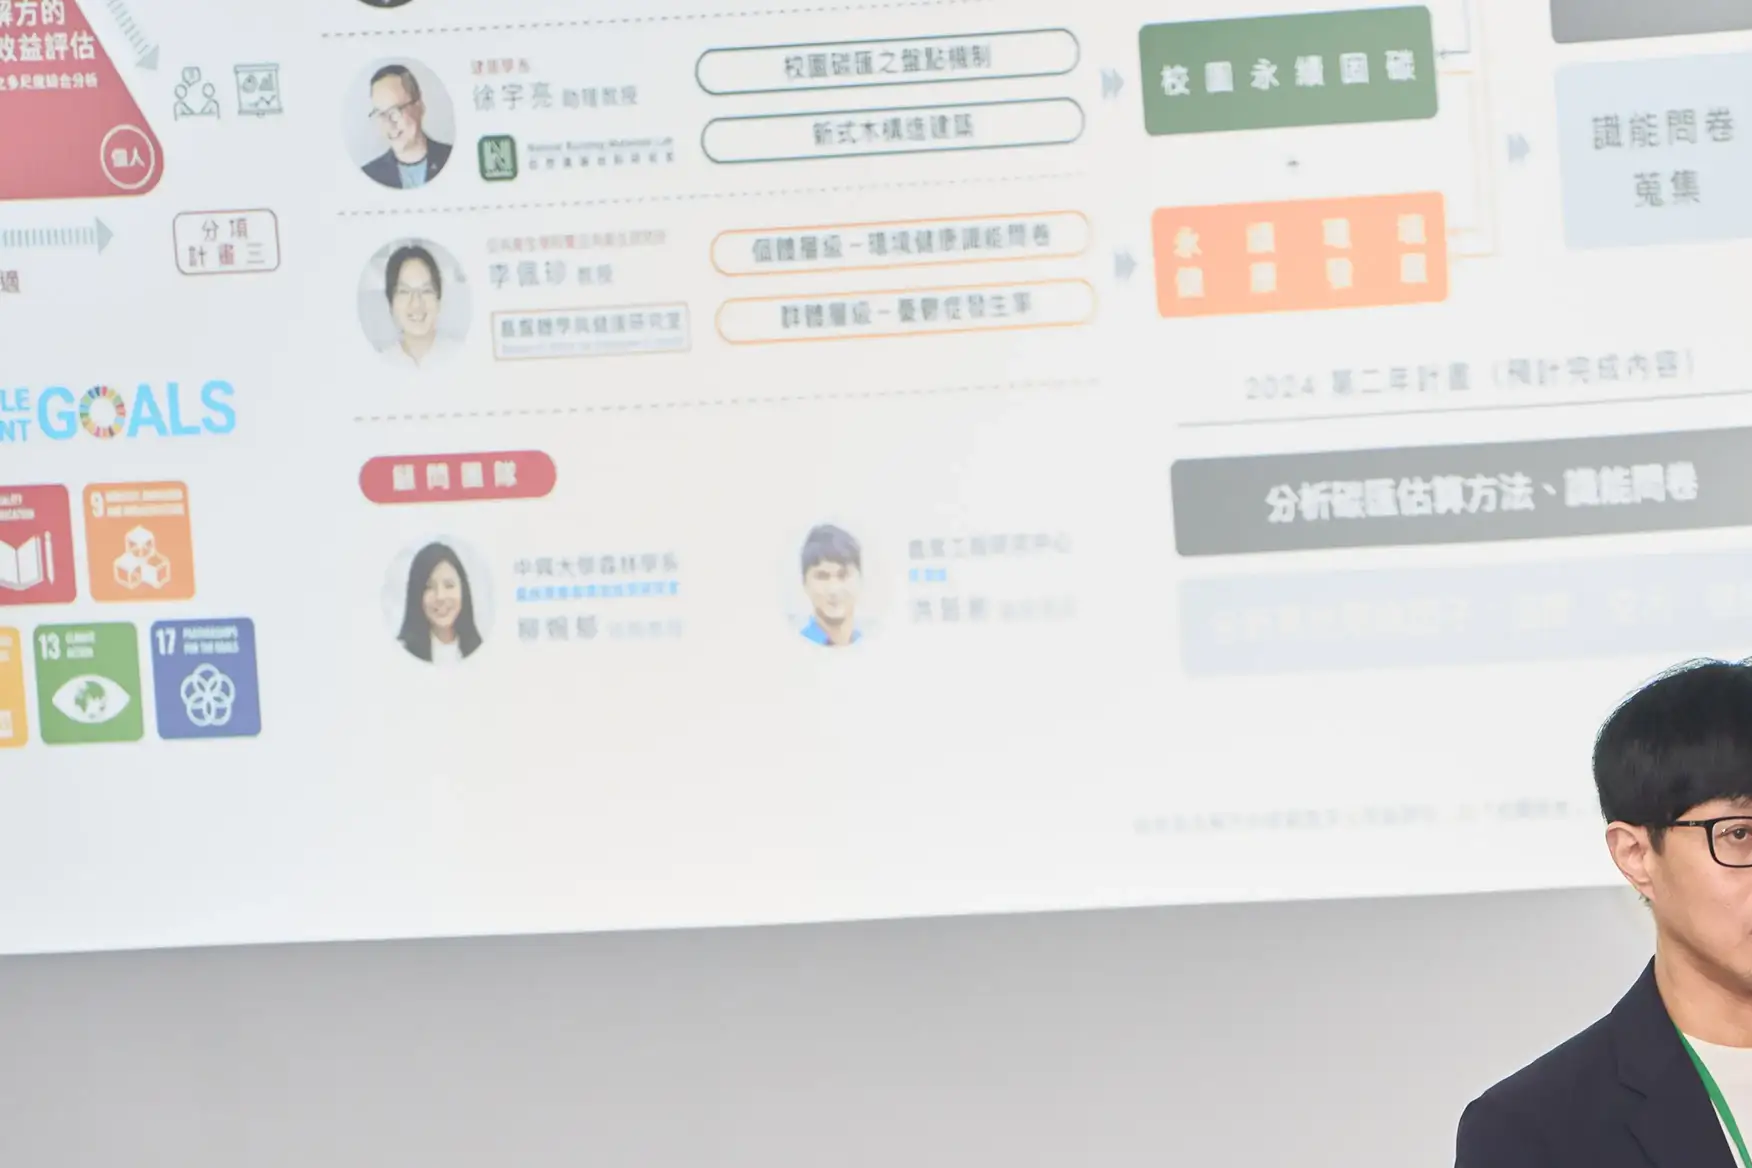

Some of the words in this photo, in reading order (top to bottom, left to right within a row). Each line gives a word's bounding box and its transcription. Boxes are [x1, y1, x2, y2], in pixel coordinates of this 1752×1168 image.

[1591, 107, 1735, 150] 識能問卷
[1633, 169, 1701, 208] 蒐集
[201, 217, 249, 242] 分項
[37, 378, 238, 442] GOALS
[38, 632, 61, 660] 13
[156, 627, 177, 656] 17
